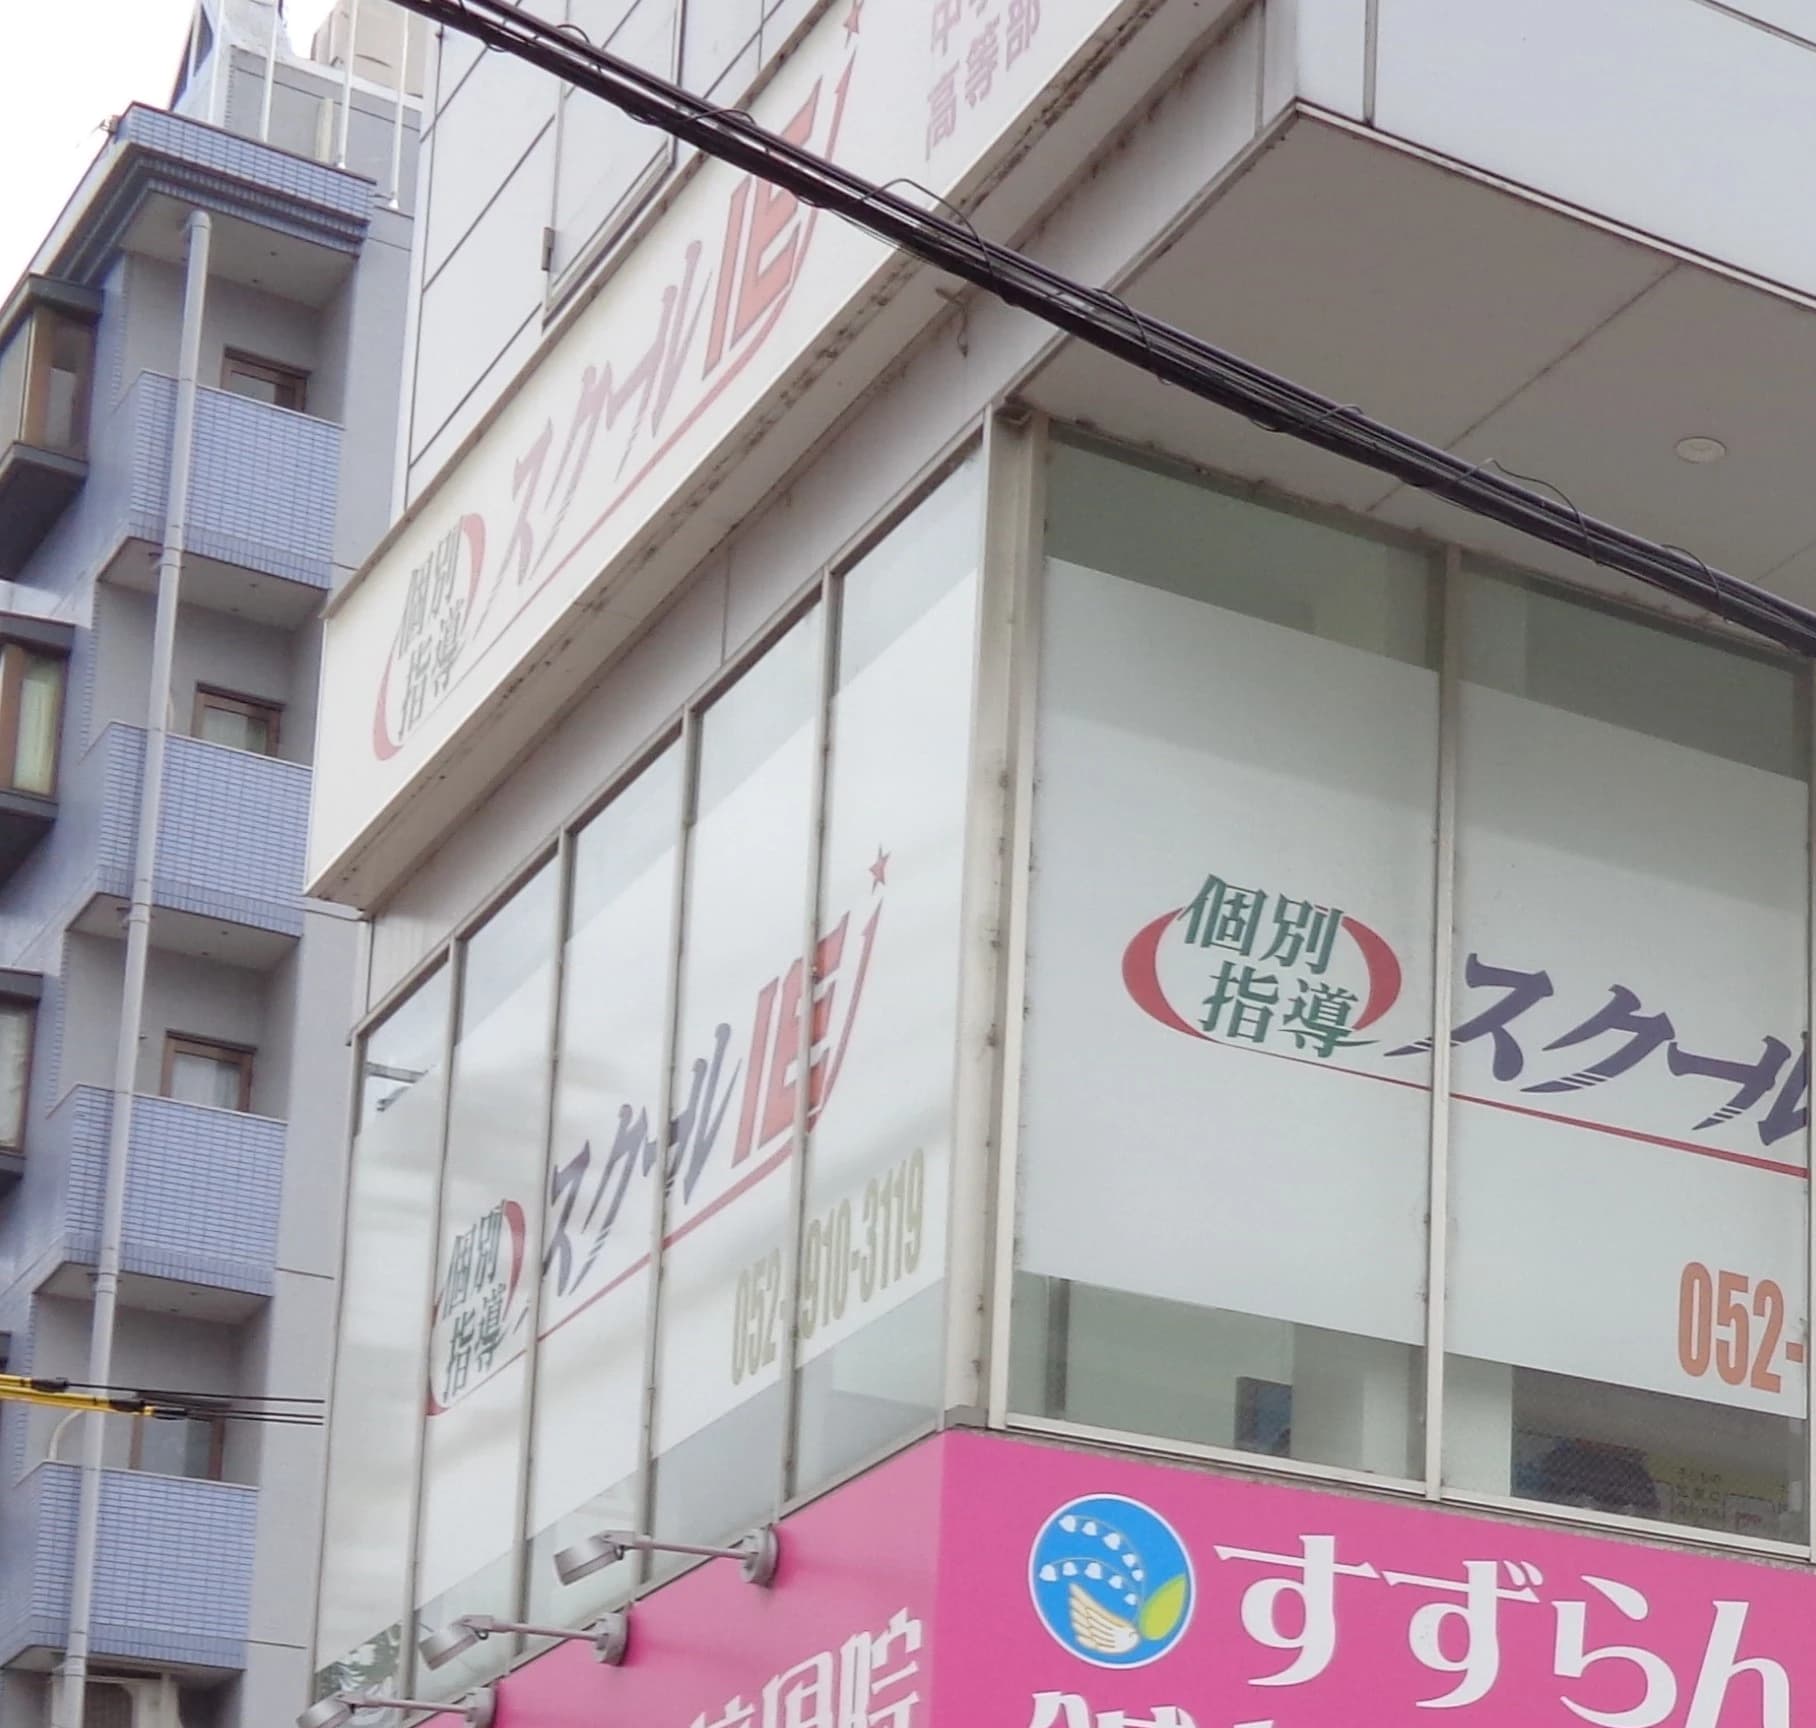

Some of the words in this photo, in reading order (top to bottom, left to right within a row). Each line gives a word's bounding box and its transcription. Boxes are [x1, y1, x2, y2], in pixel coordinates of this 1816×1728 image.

[1179, 873, 1344, 976] 個別
[1198, 961, 1381, 1058] 指導
[440, 1205, 505, 1319] 個別
[442, 1284, 507, 1400] 指導
